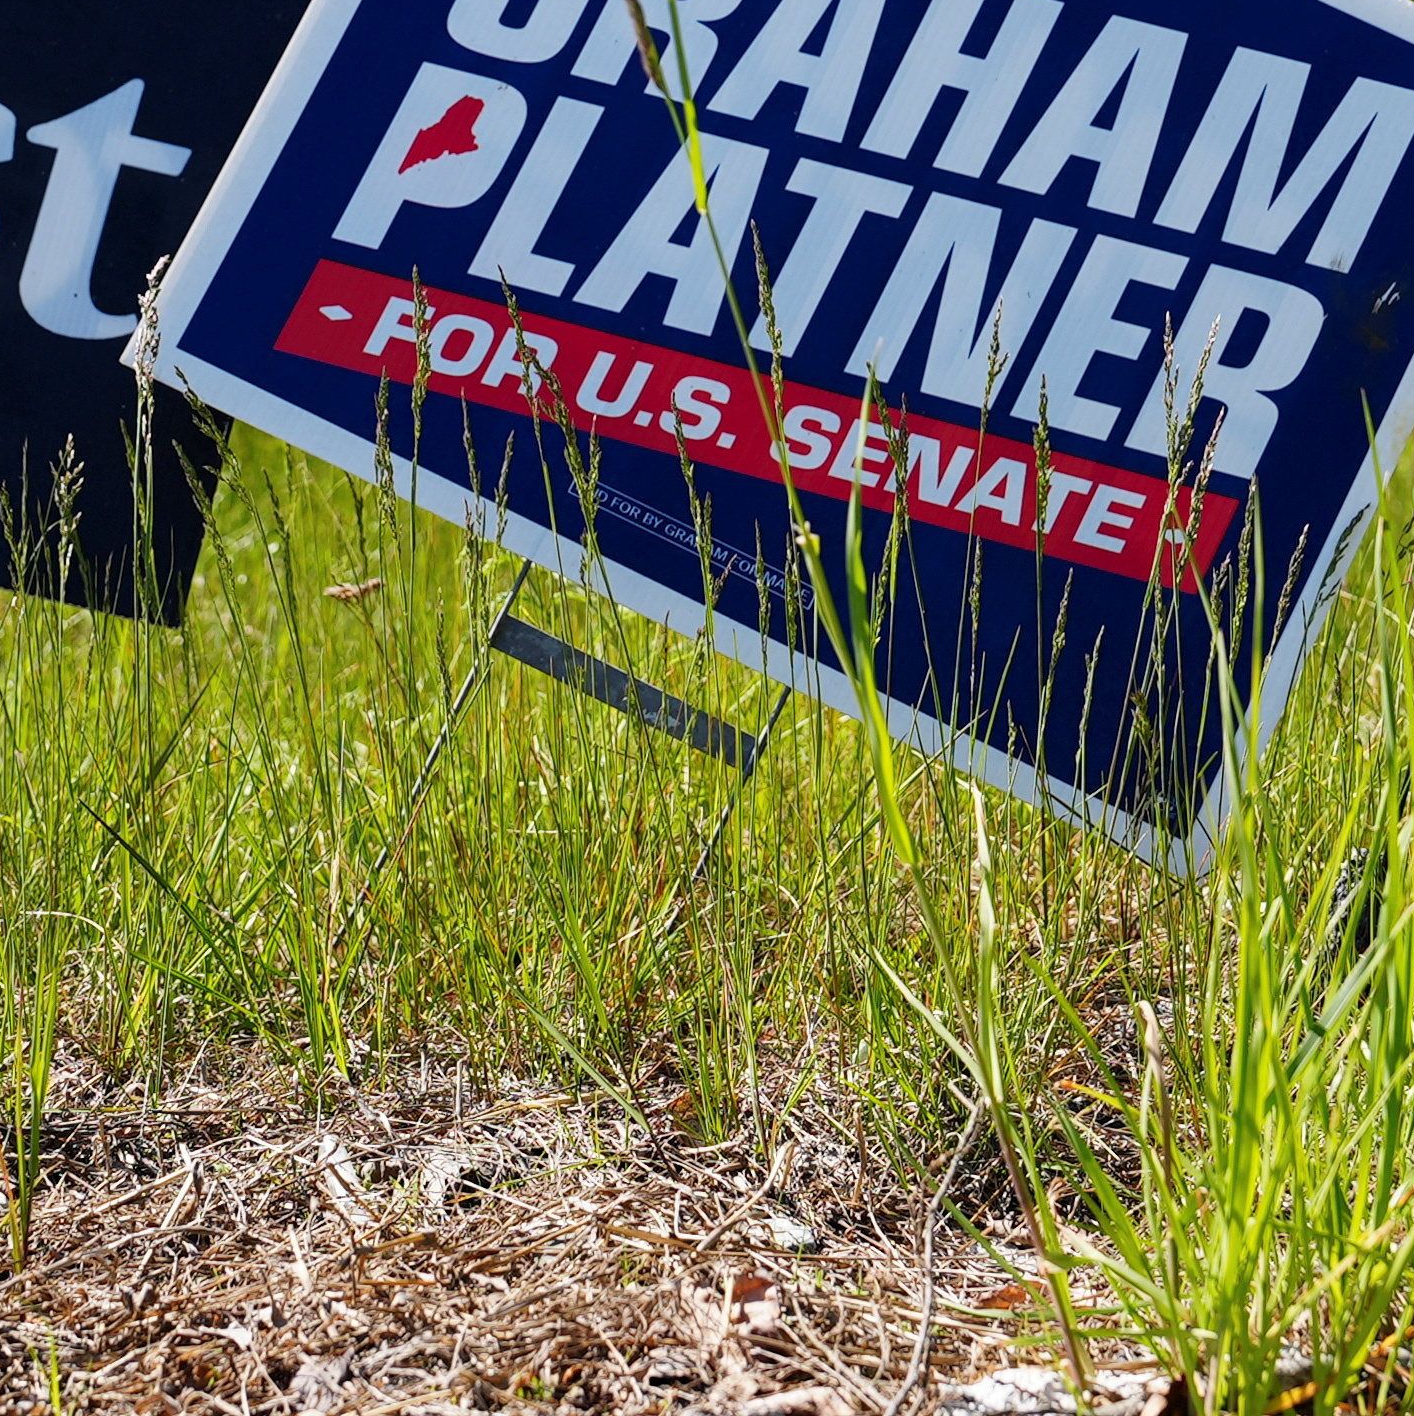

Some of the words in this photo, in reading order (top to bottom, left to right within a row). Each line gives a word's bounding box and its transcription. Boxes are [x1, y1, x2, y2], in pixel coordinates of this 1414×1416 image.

[331, 61, 1328, 481] PLATNER
[362, 295, 559, 399] FOR
[575, 350, 737, 450] U.S.
[769, 404, 1147, 554] SENATE
[609, 495, 642, 520] FOR
[641, 511, 664, 529] BY
[663, 523, 729, 562] GRAM
[761, 570, 811, 603] MAE
